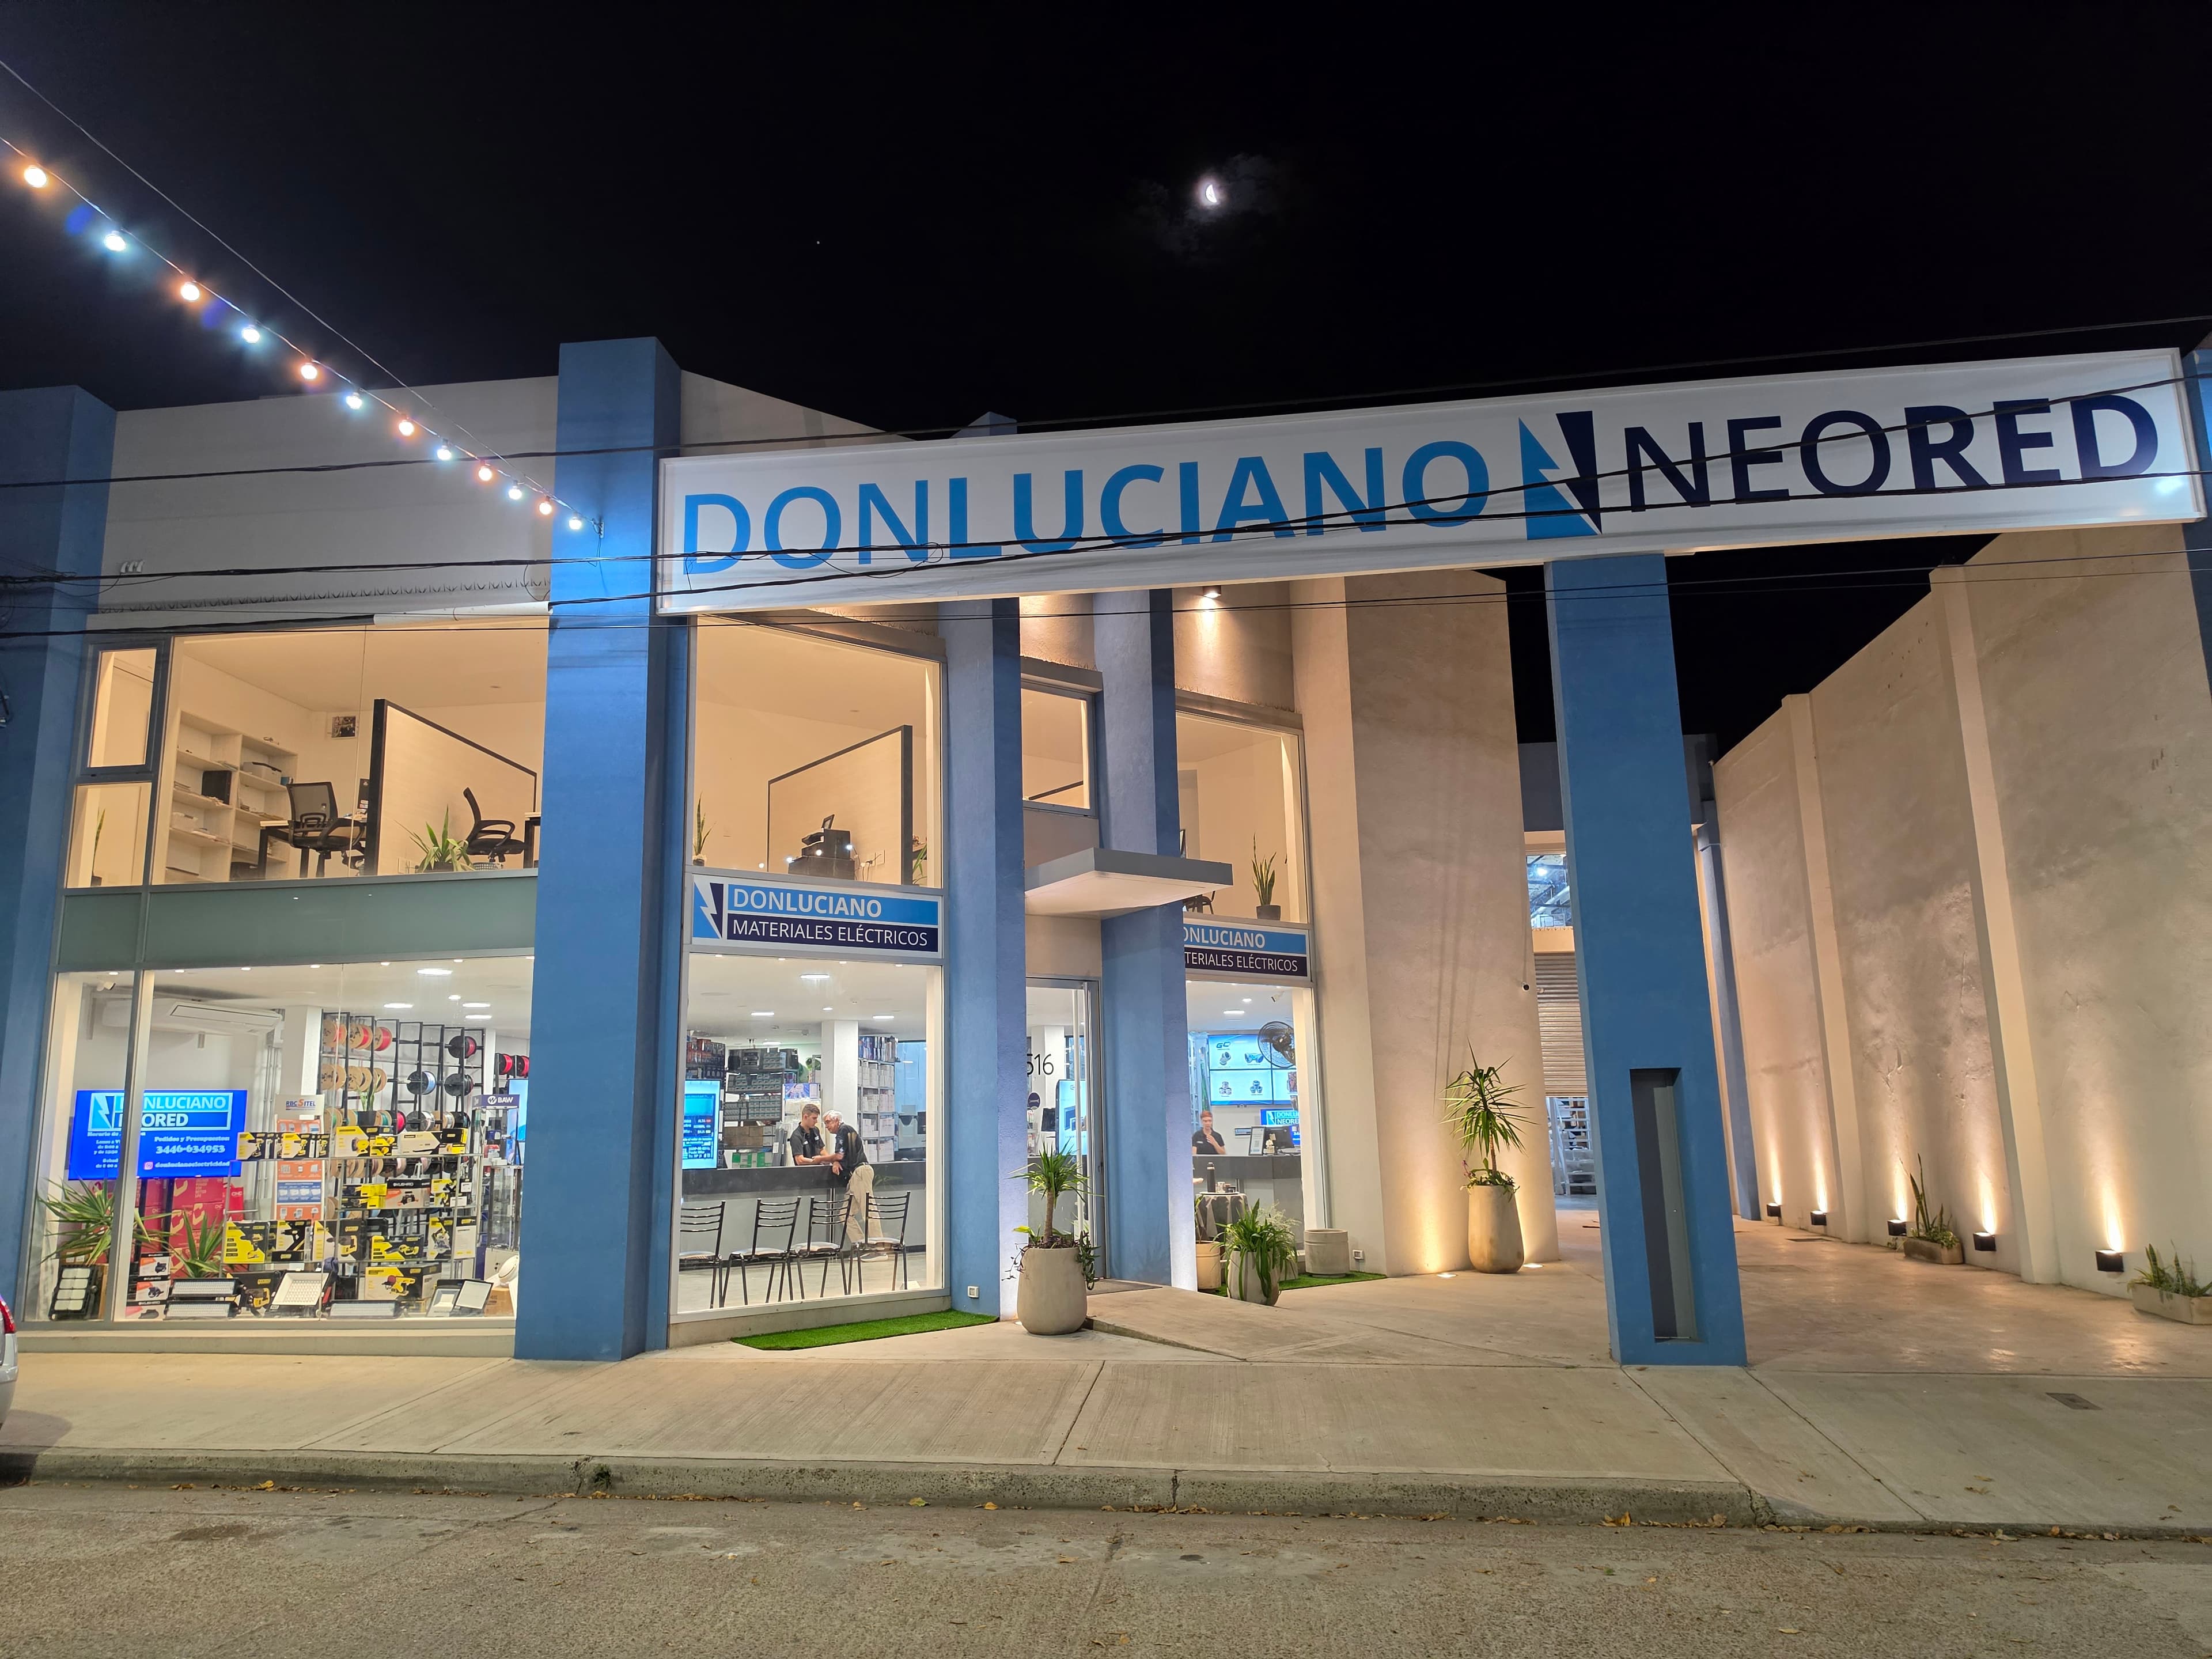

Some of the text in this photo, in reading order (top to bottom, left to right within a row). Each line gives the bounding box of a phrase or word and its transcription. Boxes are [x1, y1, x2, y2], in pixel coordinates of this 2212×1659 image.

[682, 393, 2158, 575] DONLUCIANO NEORED
[733, 888, 882, 918] DONLUCIANO
[733, 919, 928, 946] MATERIALES ELÉCTRICOS
[1183, 926, 1266, 949] ONLUCIANO
[1185, 951, 1298, 972] TERIALES ELÉCTRICOS
[120, 1096, 226, 1111] NLUCIANO
